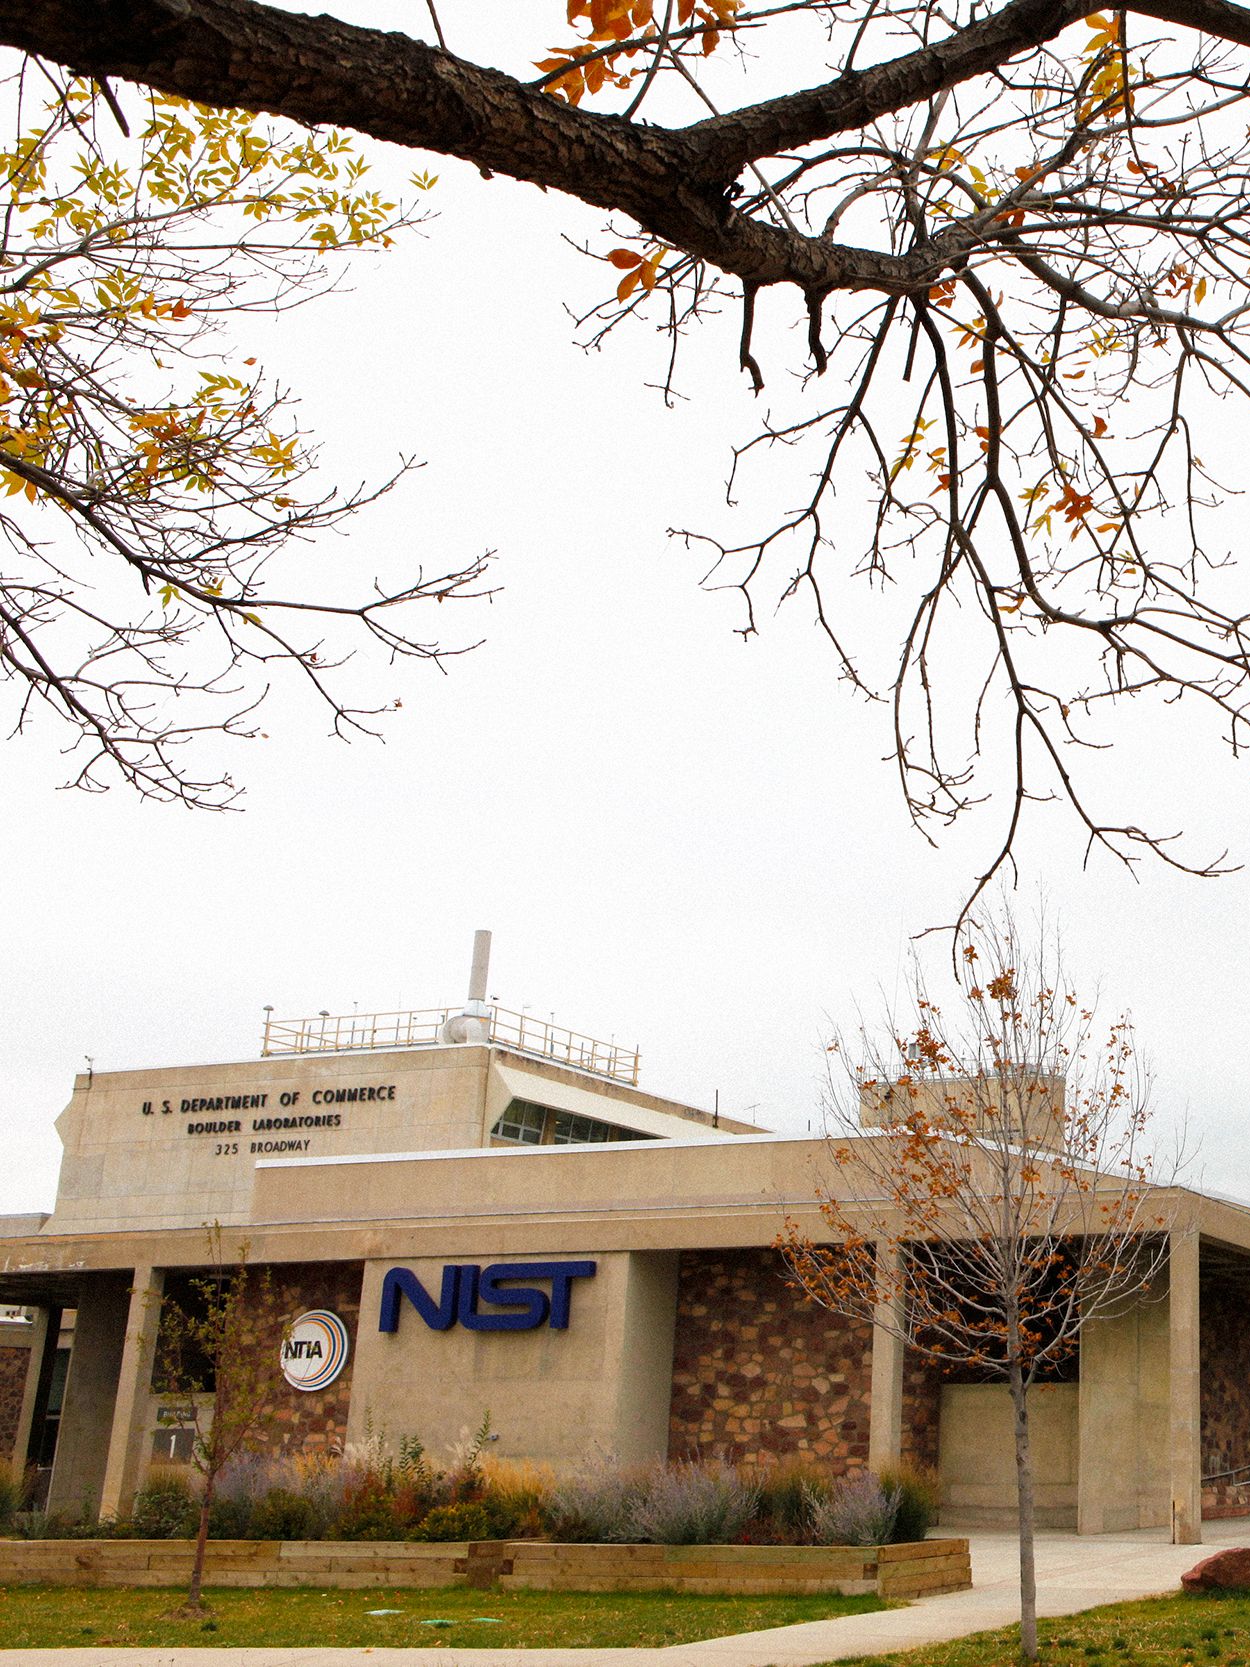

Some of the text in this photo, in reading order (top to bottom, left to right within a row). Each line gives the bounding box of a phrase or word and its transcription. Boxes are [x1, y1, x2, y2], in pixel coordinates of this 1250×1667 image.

[142, 1086, 396, 1115] U. S. DEPARTMENT OF COMMERCE
[187, 1115, 341, 1134] BOULDER LABORATORIES
[215, 1140, 311, 1156] 325 BROADWAY
[378, 1260, 597, 1333] NIST
[284, 1340, 323, 1359] NTIA
[170, 1434, 177, 1459] 1
